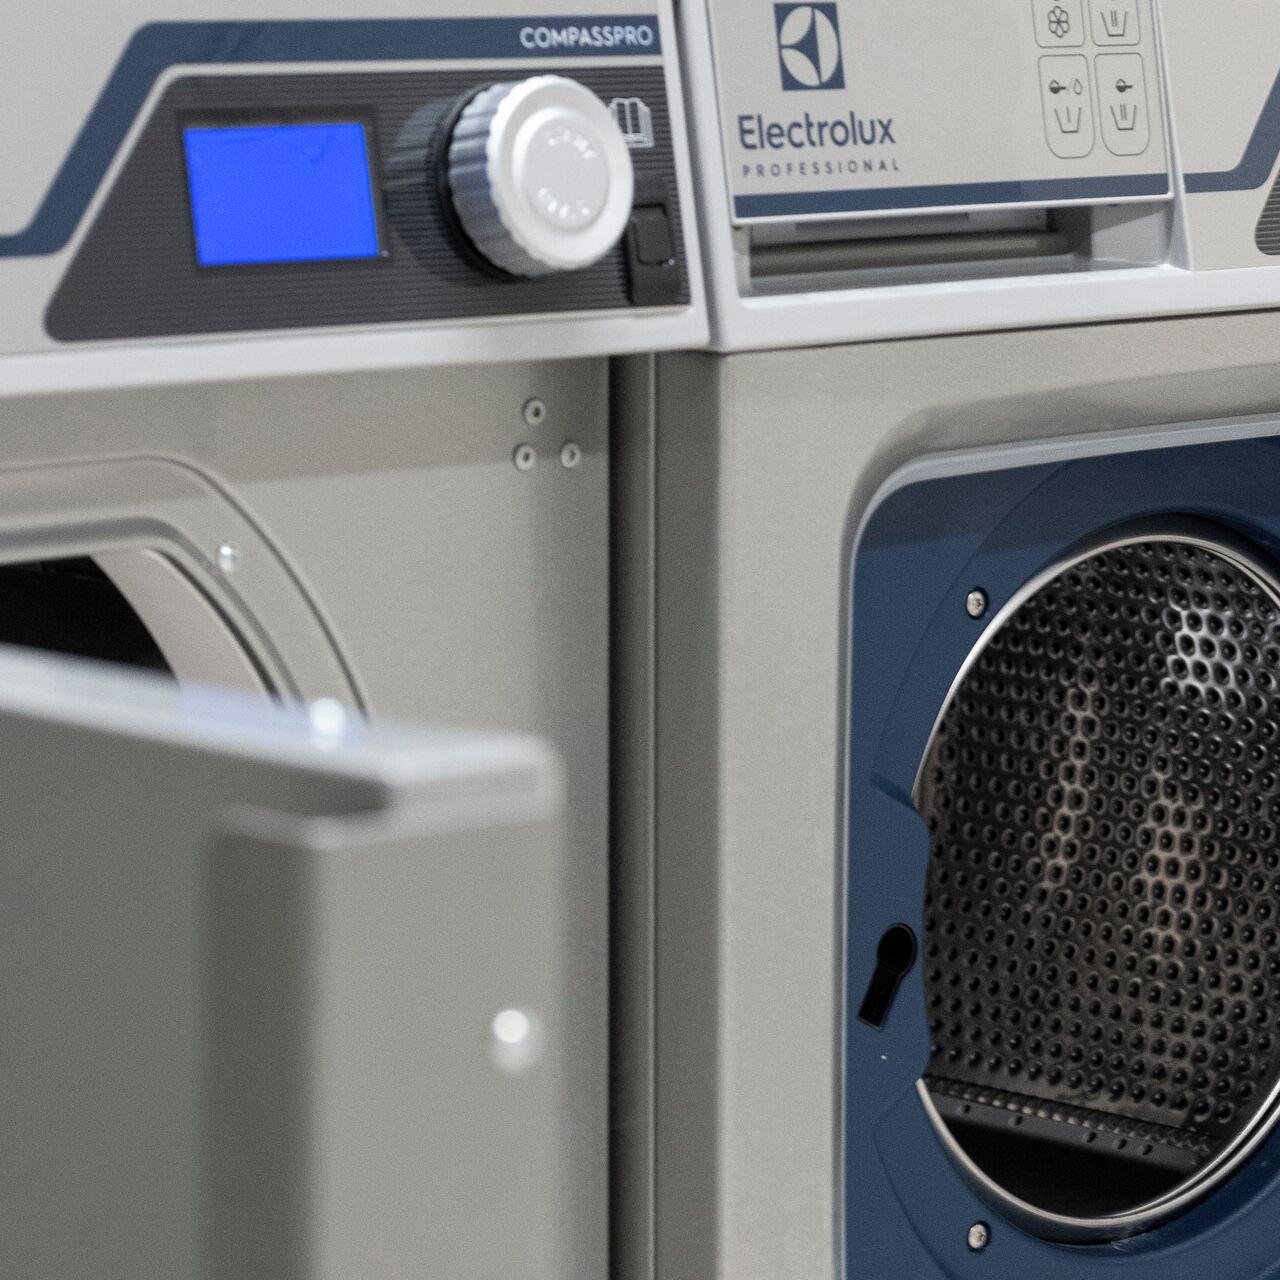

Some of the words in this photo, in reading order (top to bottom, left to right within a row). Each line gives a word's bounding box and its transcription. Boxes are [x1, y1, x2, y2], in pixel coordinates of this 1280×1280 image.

[519, 24, 653, 49] COMPASSPRO
[737, 110, 896, 150] Electrolux
[742, 158, 900, 178] PROFESSIONAL
